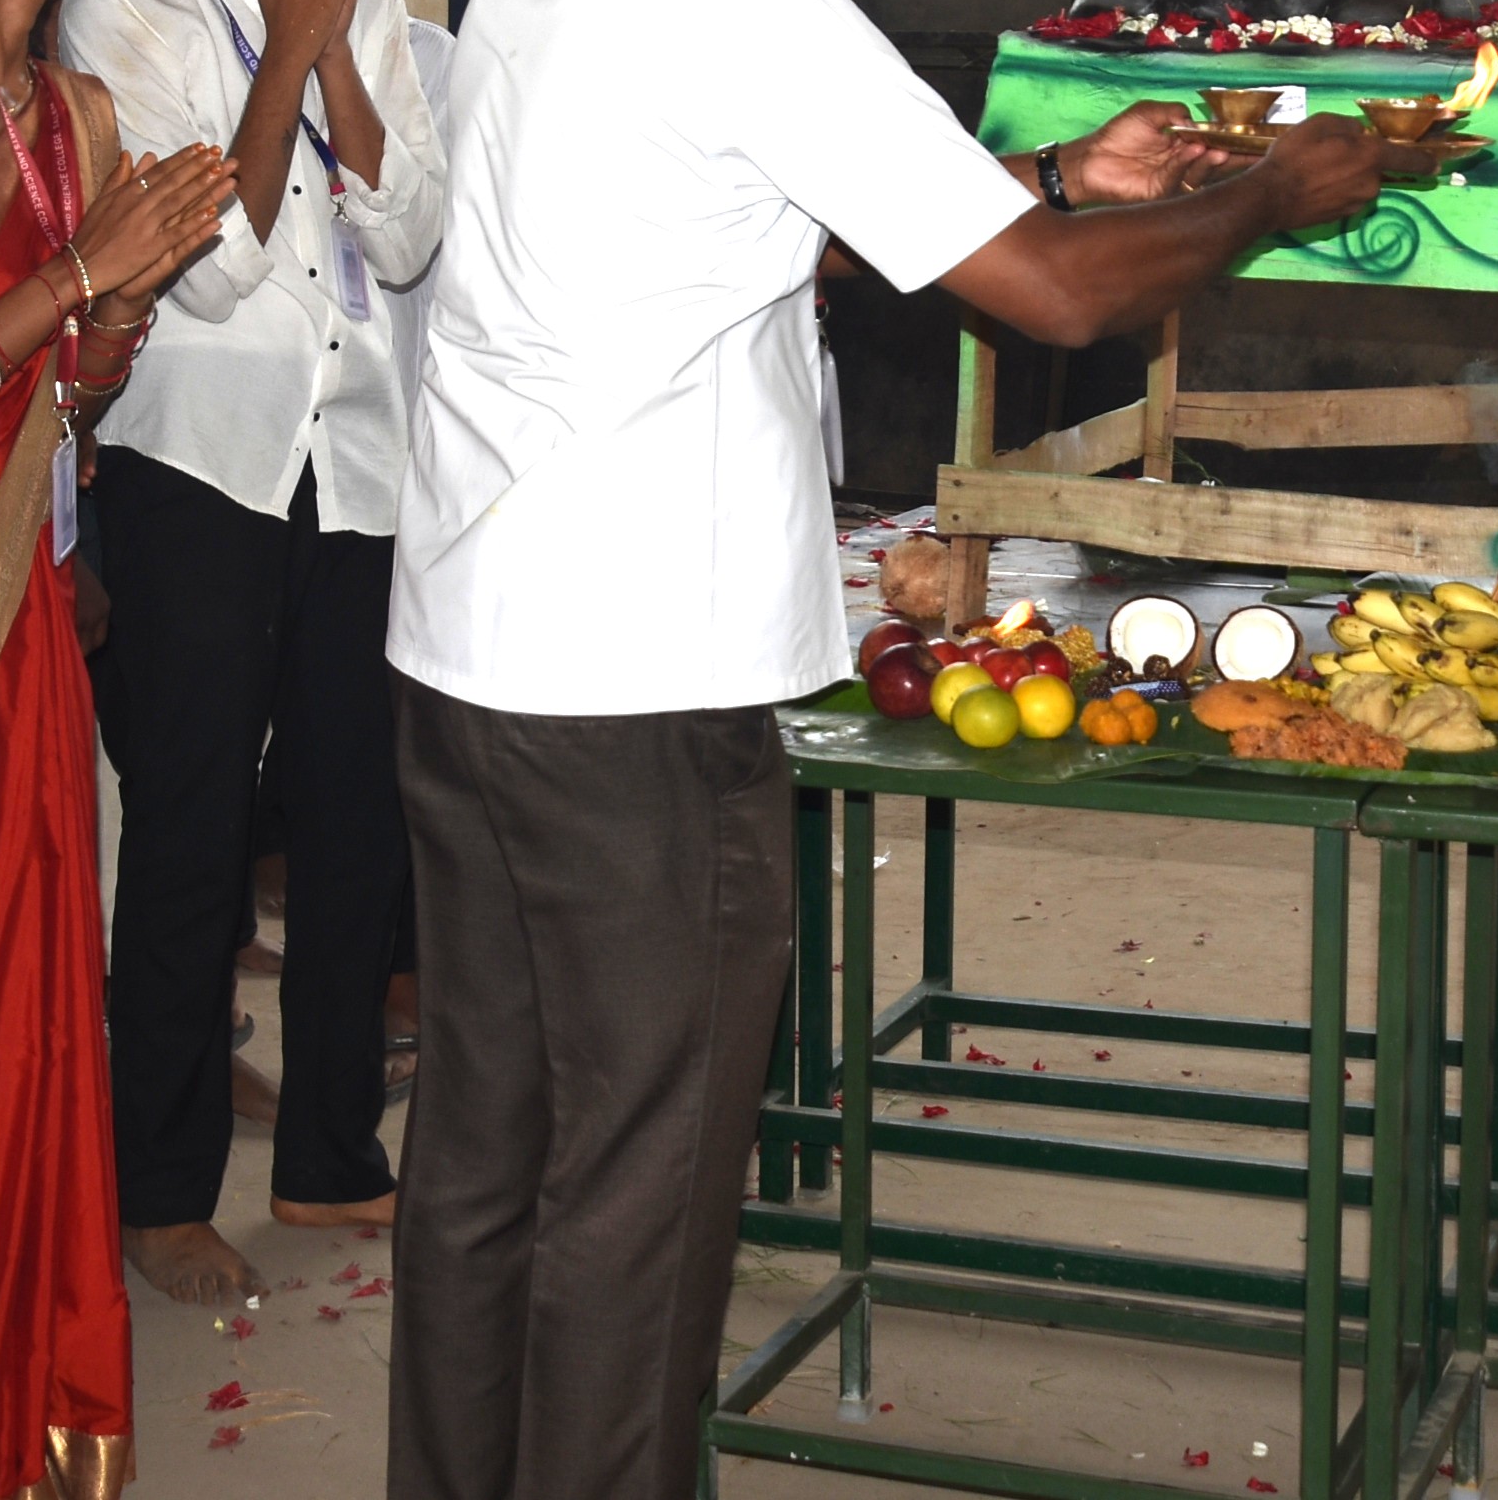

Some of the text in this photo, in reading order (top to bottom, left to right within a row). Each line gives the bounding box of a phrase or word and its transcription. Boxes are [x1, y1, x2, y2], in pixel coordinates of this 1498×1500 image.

[53, 132, 67, 172] COLLEGE
[16, 151, 29, 170] AND
[23, 171, 44, 210] SCIENCE
[37, 210, 60, 248] COLLEGE
[59, 173, 72, 211] SCIENCE
[66, 213, 74, 232] AND
